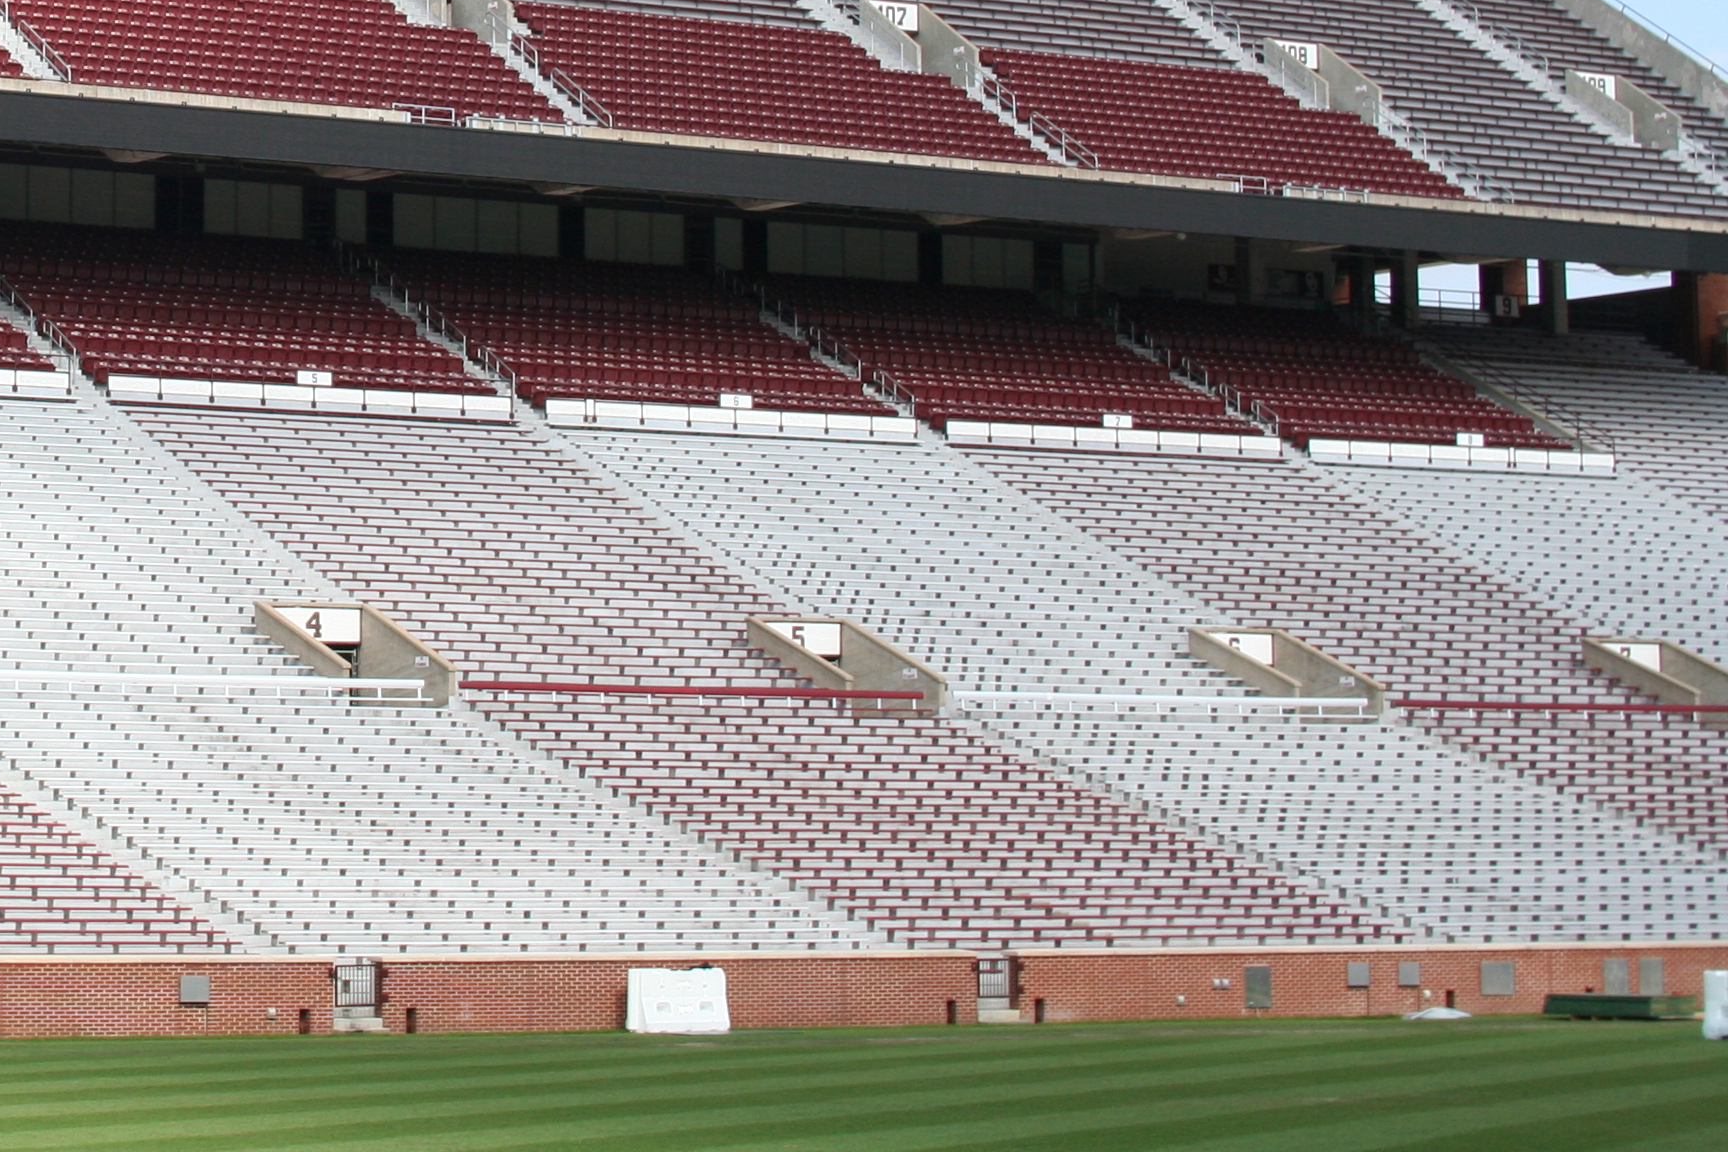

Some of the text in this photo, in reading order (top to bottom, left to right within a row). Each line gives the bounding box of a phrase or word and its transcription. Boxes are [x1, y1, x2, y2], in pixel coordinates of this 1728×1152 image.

[1502, 298, 1512, 315] 9
[305, 611, 321, 638] 4
[791, 626, 805, 649] 5
